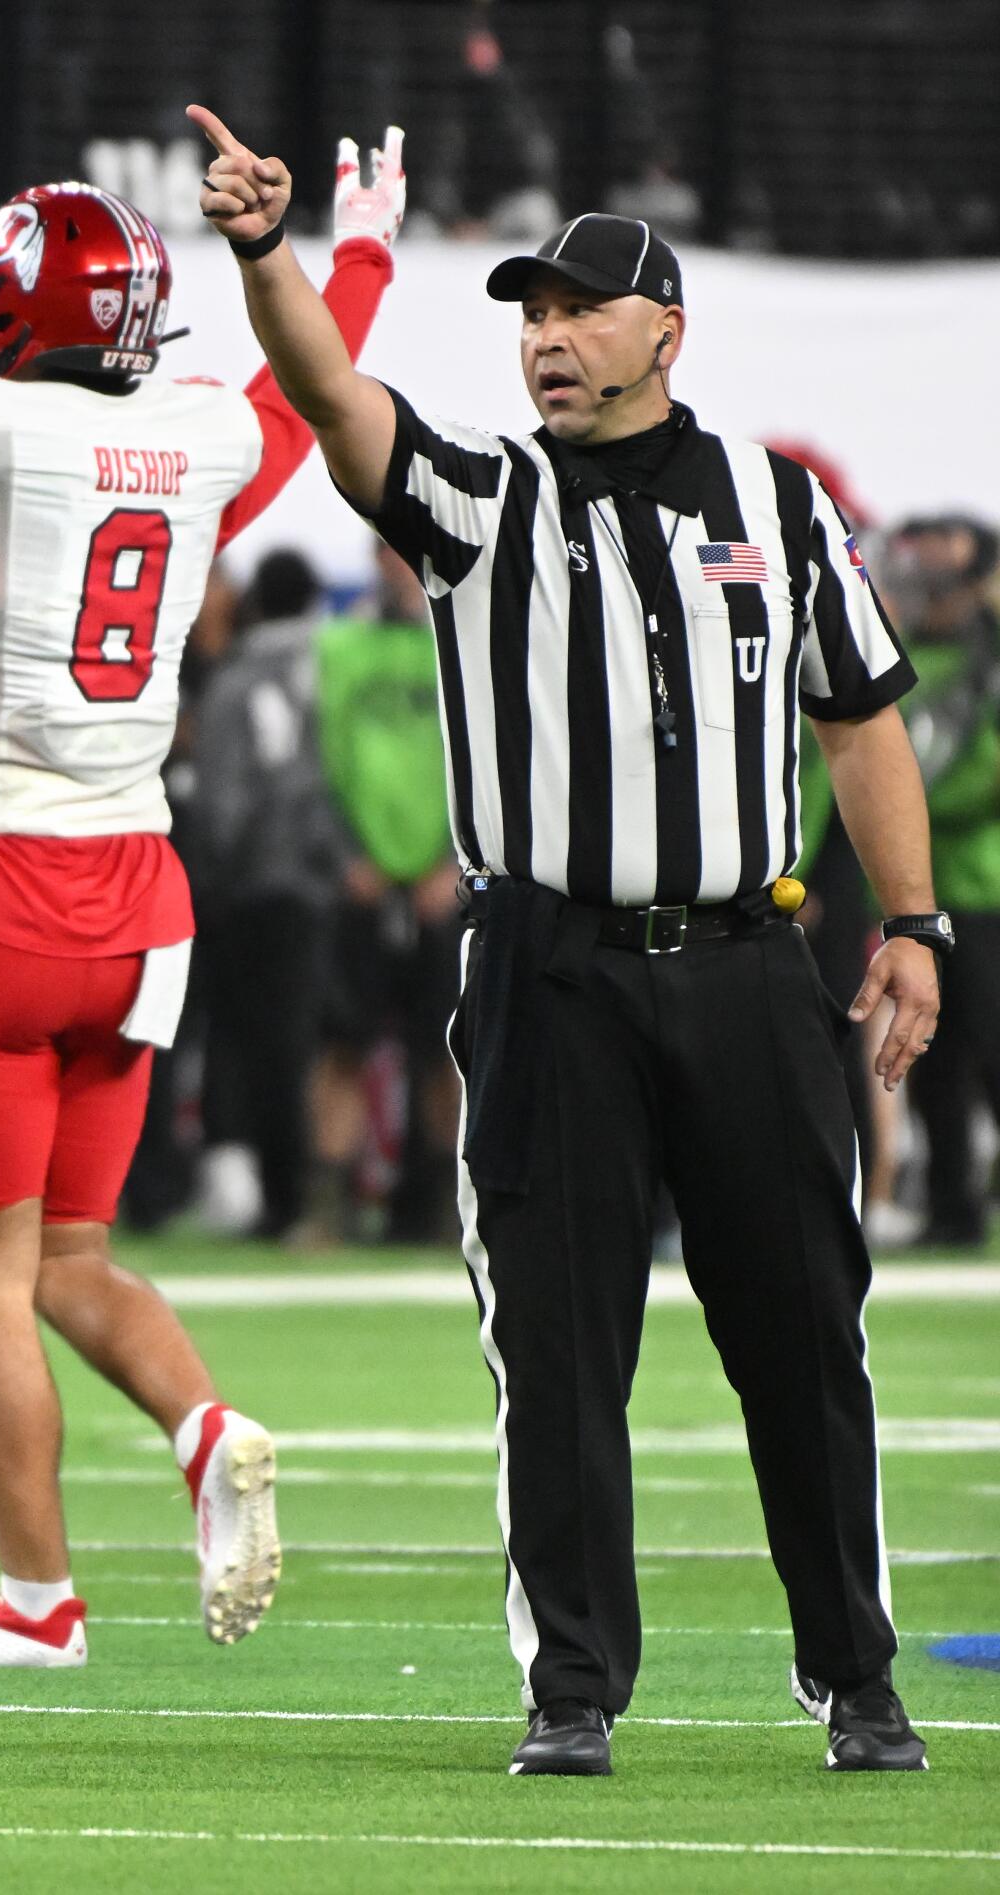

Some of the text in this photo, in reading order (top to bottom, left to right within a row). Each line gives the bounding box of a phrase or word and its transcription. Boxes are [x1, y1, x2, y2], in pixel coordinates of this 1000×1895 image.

[102, 351, 153, 372] UTES
[93, 446, 189, 496] BISHOP
[68, 506, 173, 703] 8
[735, 636, 766, 683] U
